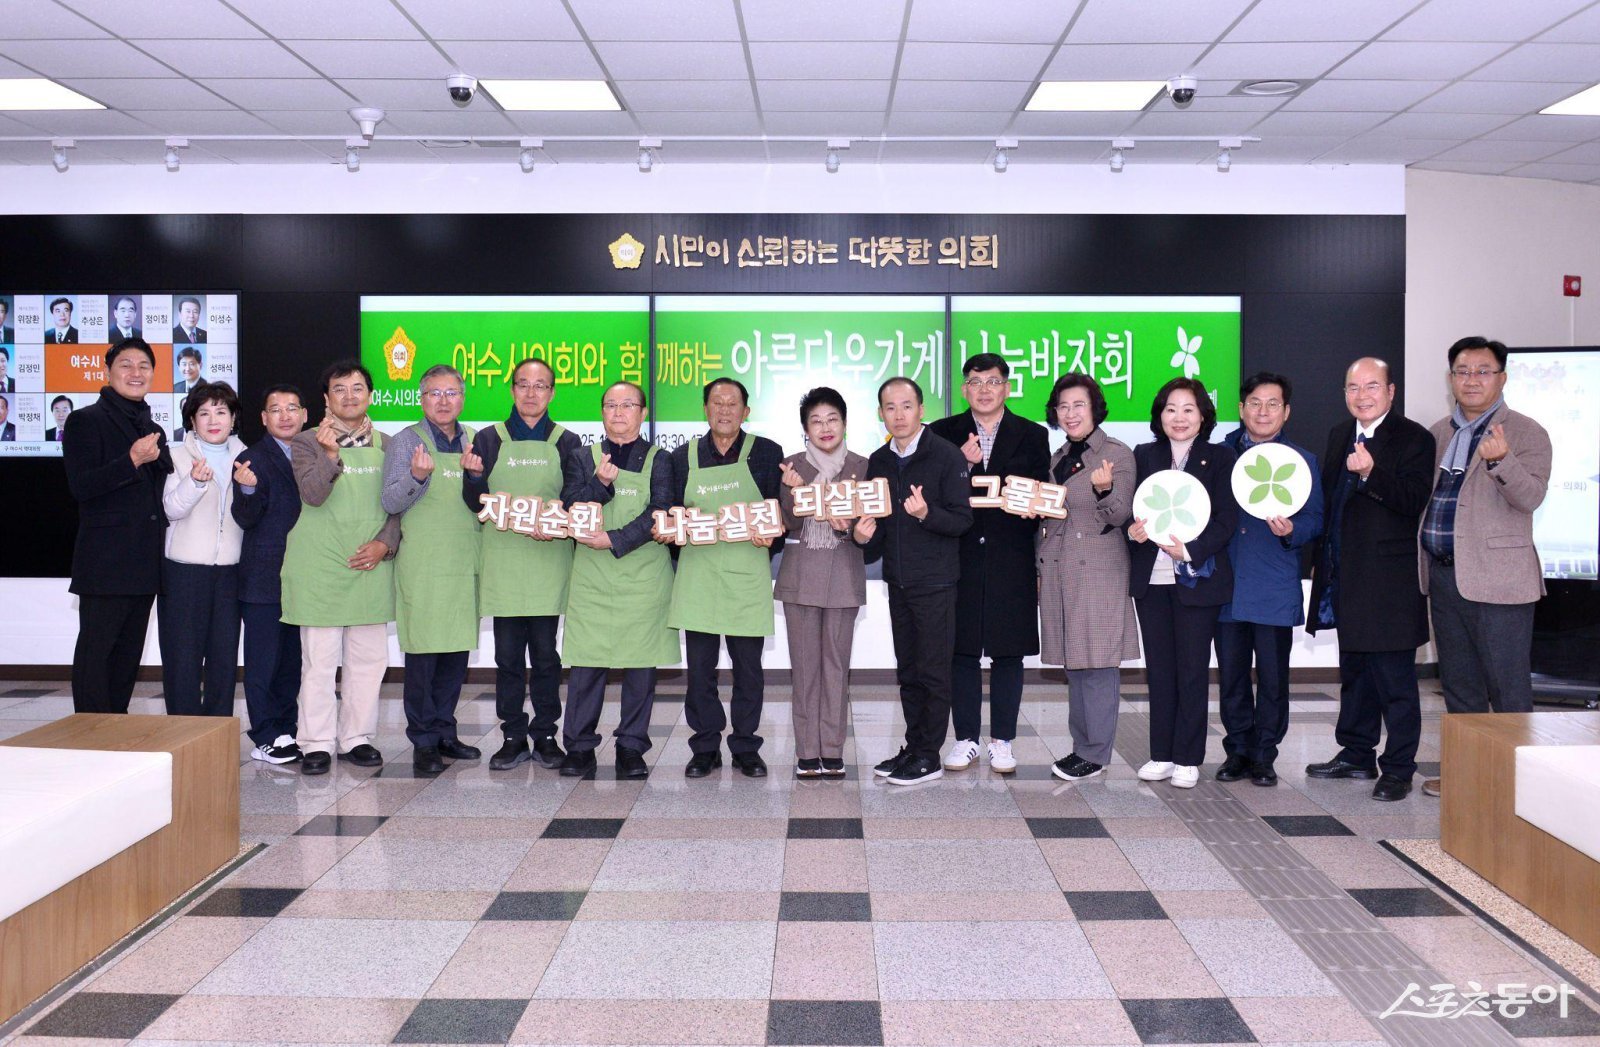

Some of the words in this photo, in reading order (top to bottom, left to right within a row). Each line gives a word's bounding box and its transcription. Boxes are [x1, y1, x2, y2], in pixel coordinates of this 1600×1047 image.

[655, 234, 729, 267] 시민이
[737, 234, 839, 267] 신뢰하는
[848, 235, 932, 268] 따뜻한
[938, 234, 998, 268] 의회
[210, 314, 233, 324] 이성수
[70, 355, 100, 368] 여수시
[394, 351, 406, 362] 의회
[151, 412, 169, 422] 창곤
[793, 479, 888, 520] 되살림
[970, 477, 1067, 517] 그물코
[478, 493, 602, 539] 자원순환
[654, 500, 781, 545] 나눔실천
